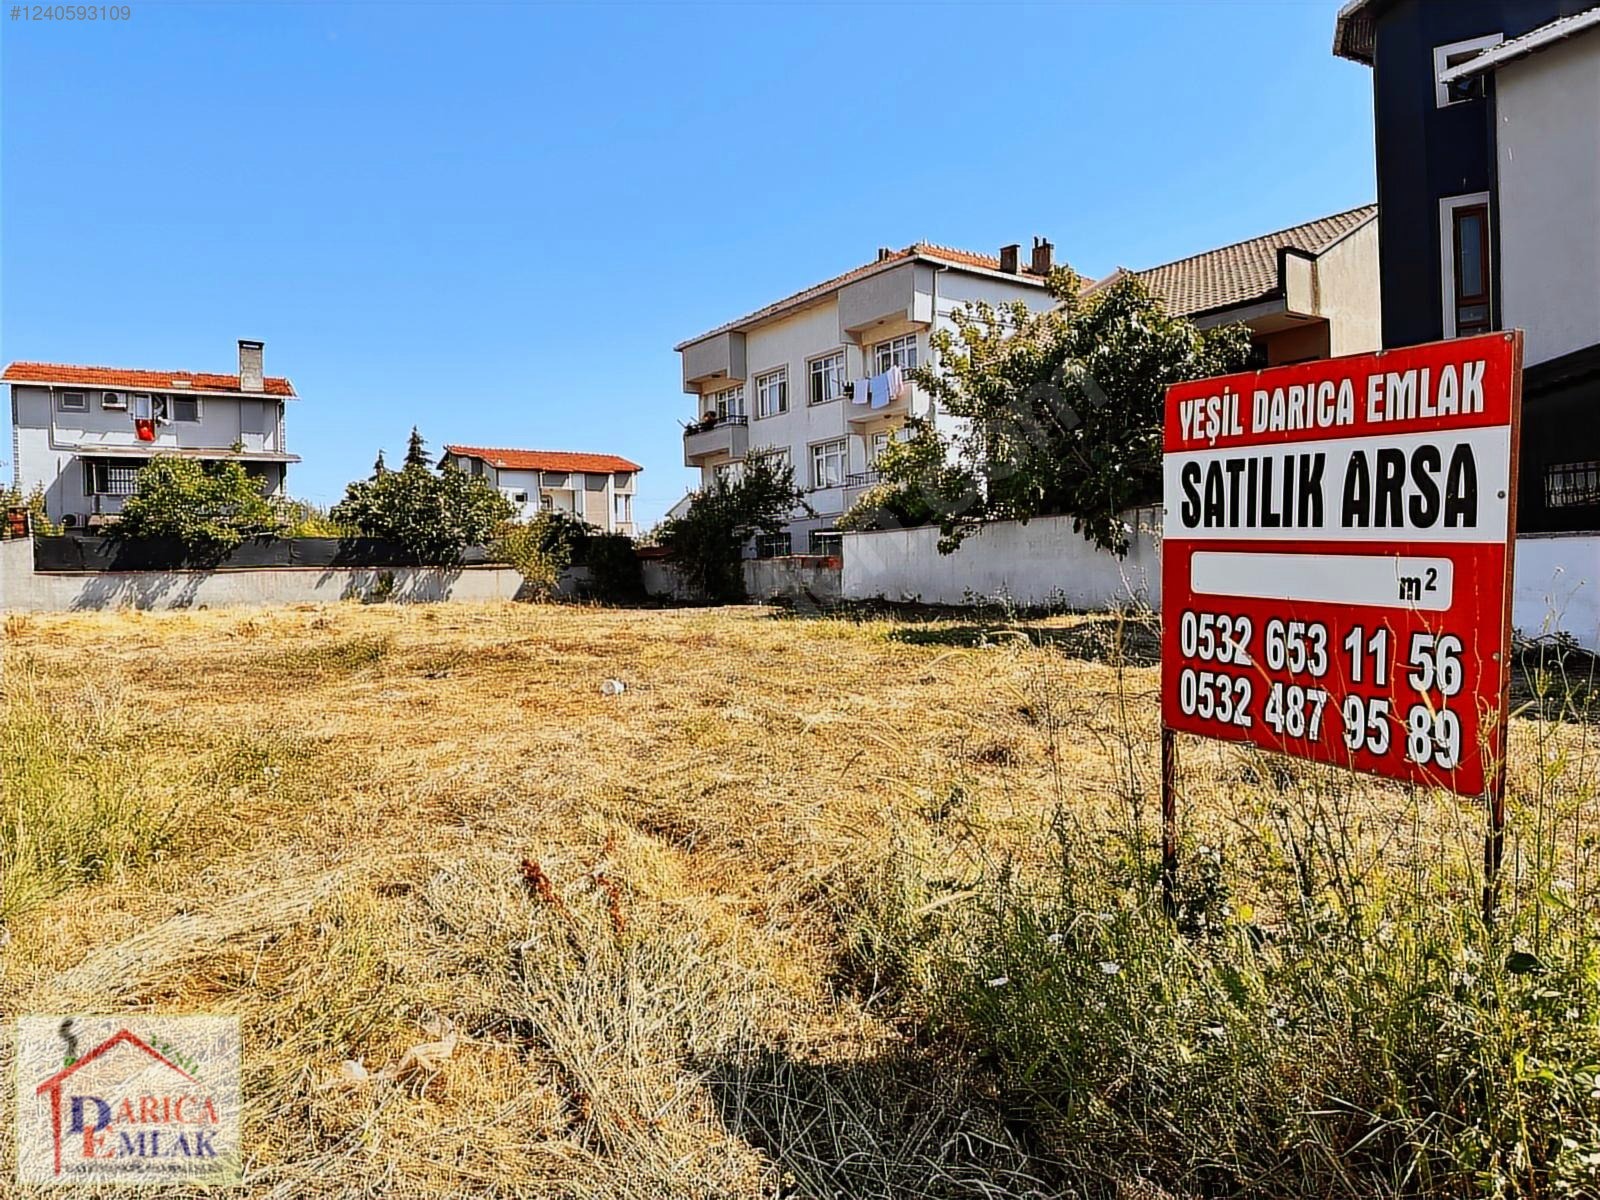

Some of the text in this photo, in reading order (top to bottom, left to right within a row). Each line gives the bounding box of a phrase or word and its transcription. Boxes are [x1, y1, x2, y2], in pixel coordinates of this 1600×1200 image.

[1179, 360, 1486, 446] YEŞİL DARICA EMLAK
[1180, 443, 1478, 529] SATILIK ARSA
[1181, 611, 1462, 695] 0532 653 11 56
[1180, 668, 1461, 769] 0532 487 95 89
